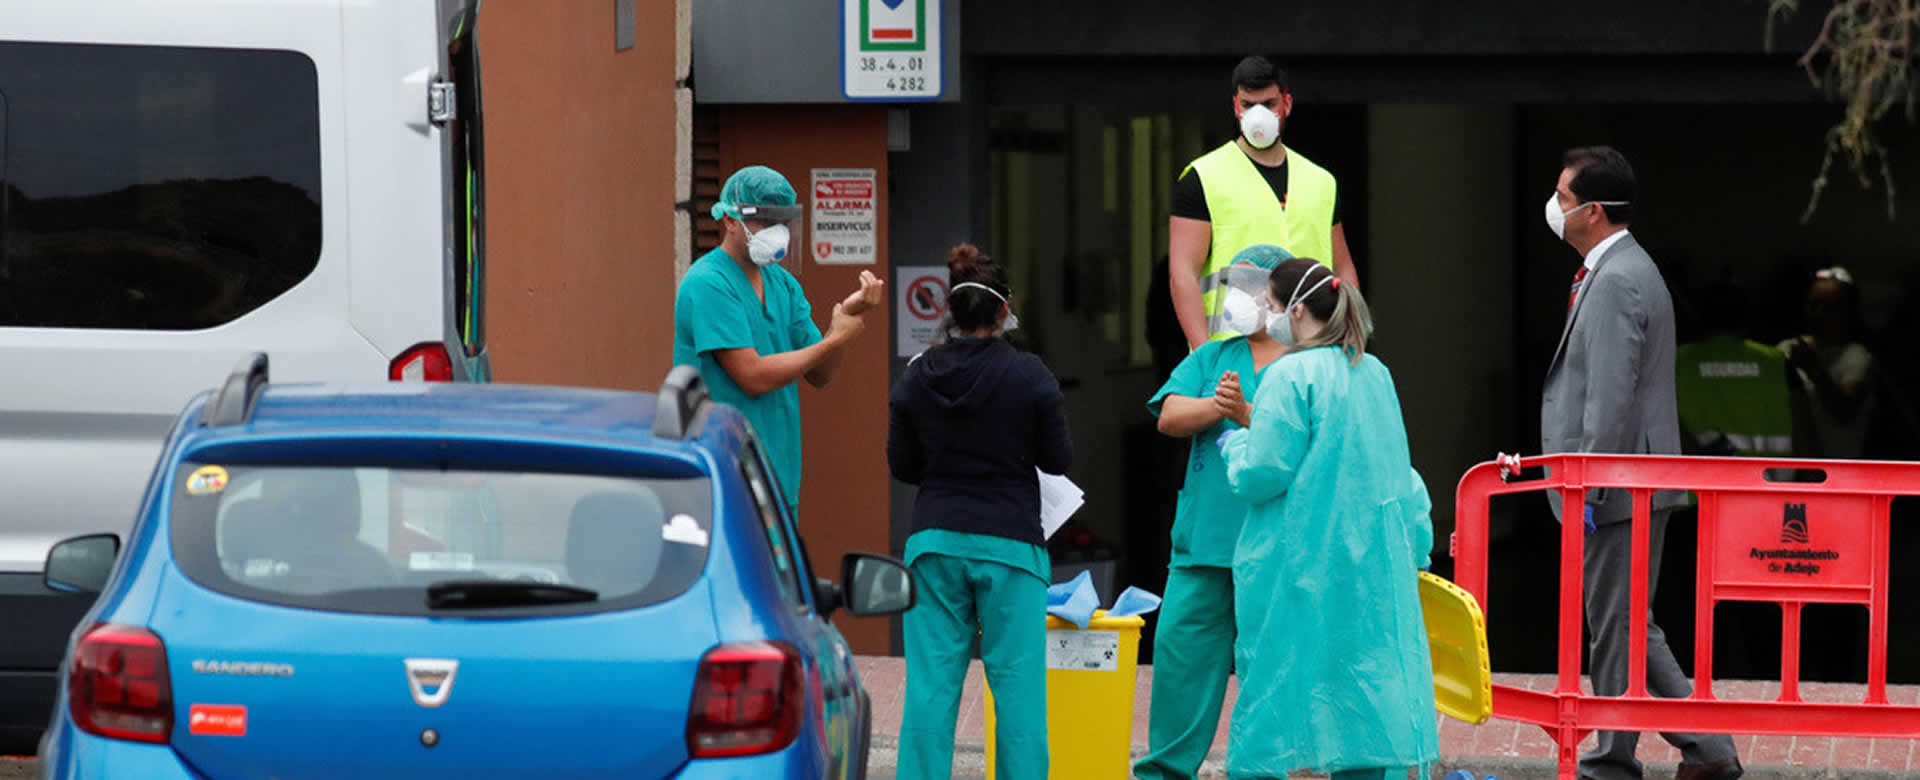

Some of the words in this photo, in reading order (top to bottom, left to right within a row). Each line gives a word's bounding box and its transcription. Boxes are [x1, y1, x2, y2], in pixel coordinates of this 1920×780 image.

[816, 201, 872, 210] ALARMA
[817, 222, 871, 231] BISERVICUS
[1750, 547, 1839, 561] Ayuntamiento
[1784, 562, 1820, 576] Adeje
[191, 659, 295, 678] SANDERO
